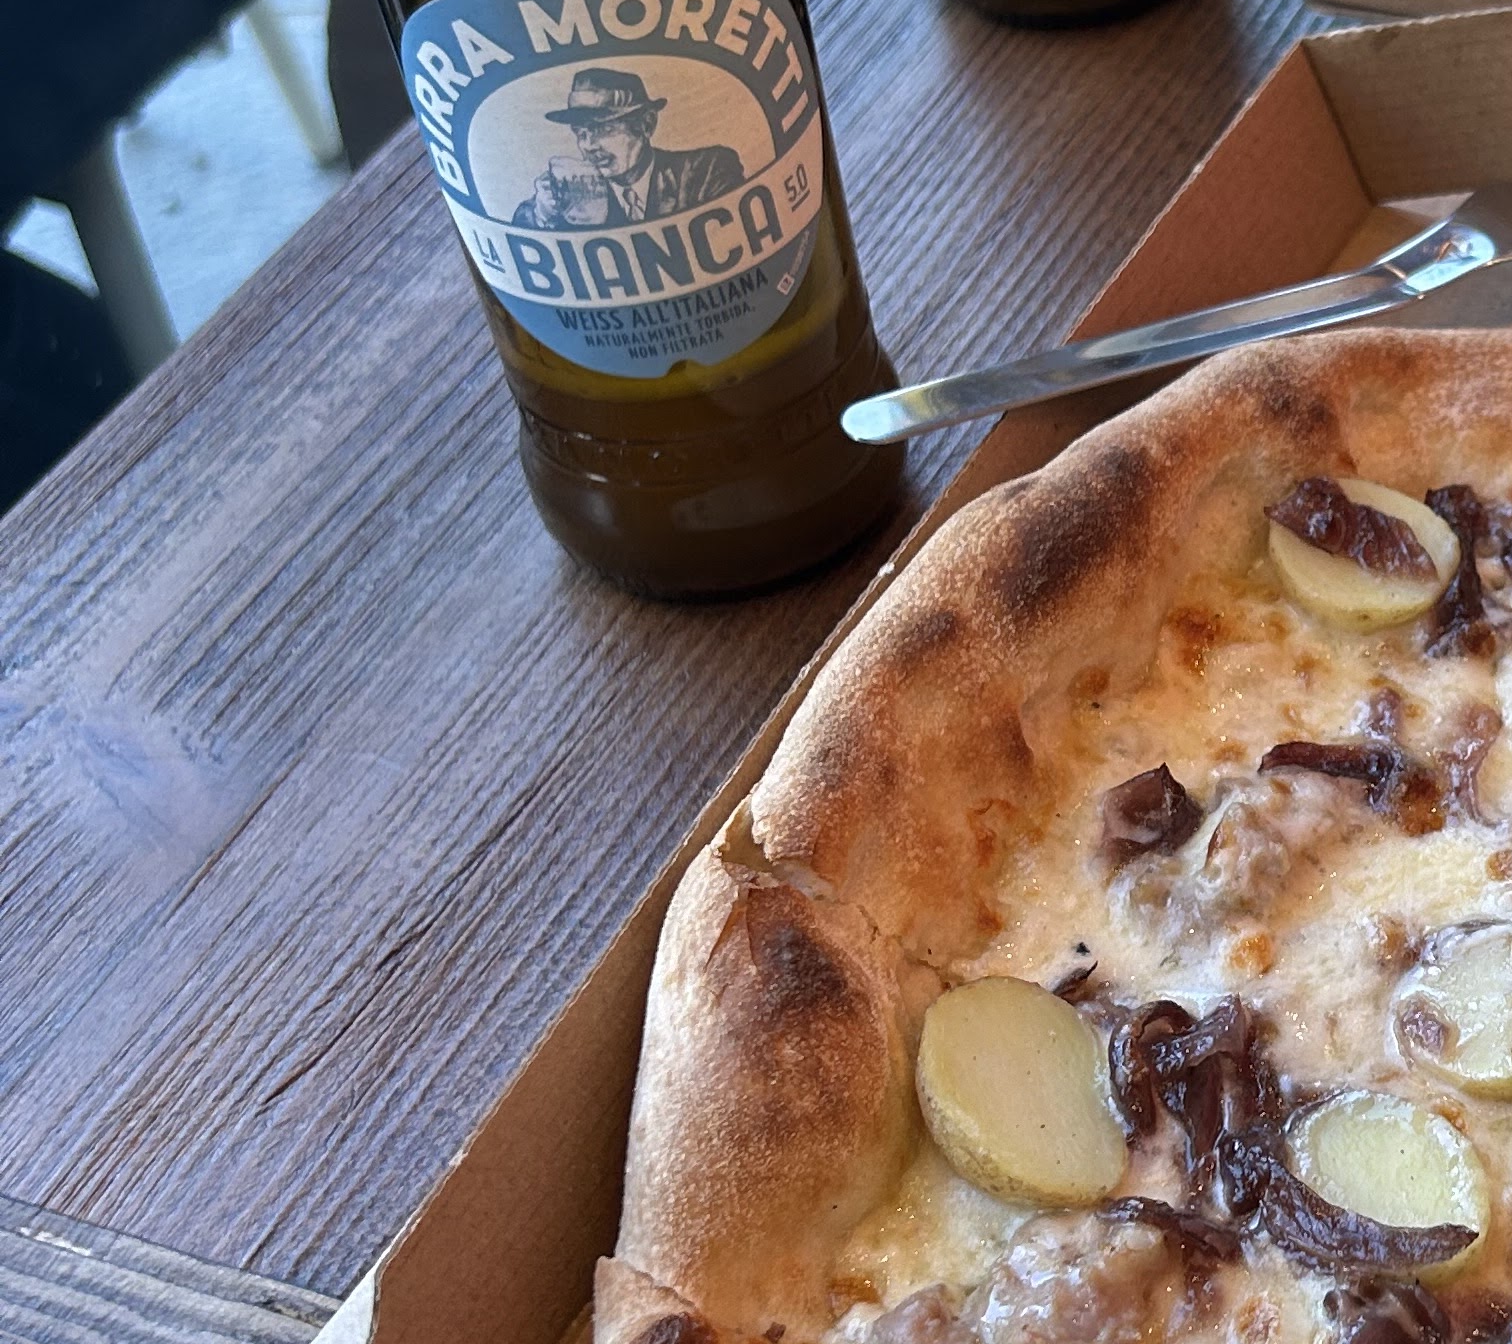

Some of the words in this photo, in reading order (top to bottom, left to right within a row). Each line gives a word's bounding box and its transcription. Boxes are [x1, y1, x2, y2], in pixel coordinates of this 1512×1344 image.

[414, 19, 515, 196] BIRRA
[473, 229, 503, 266] LA
[505, 185, 784, 301] BIANCA
[556, 308, 624, 331] WEISS
[632, 267, 769, 329] ALL'ITALIANA
[584, 322, 692, 348] NATURALMENTE
[628, 342, 658, 359] NON
[663, 329, 724, 355] FILTRATA
